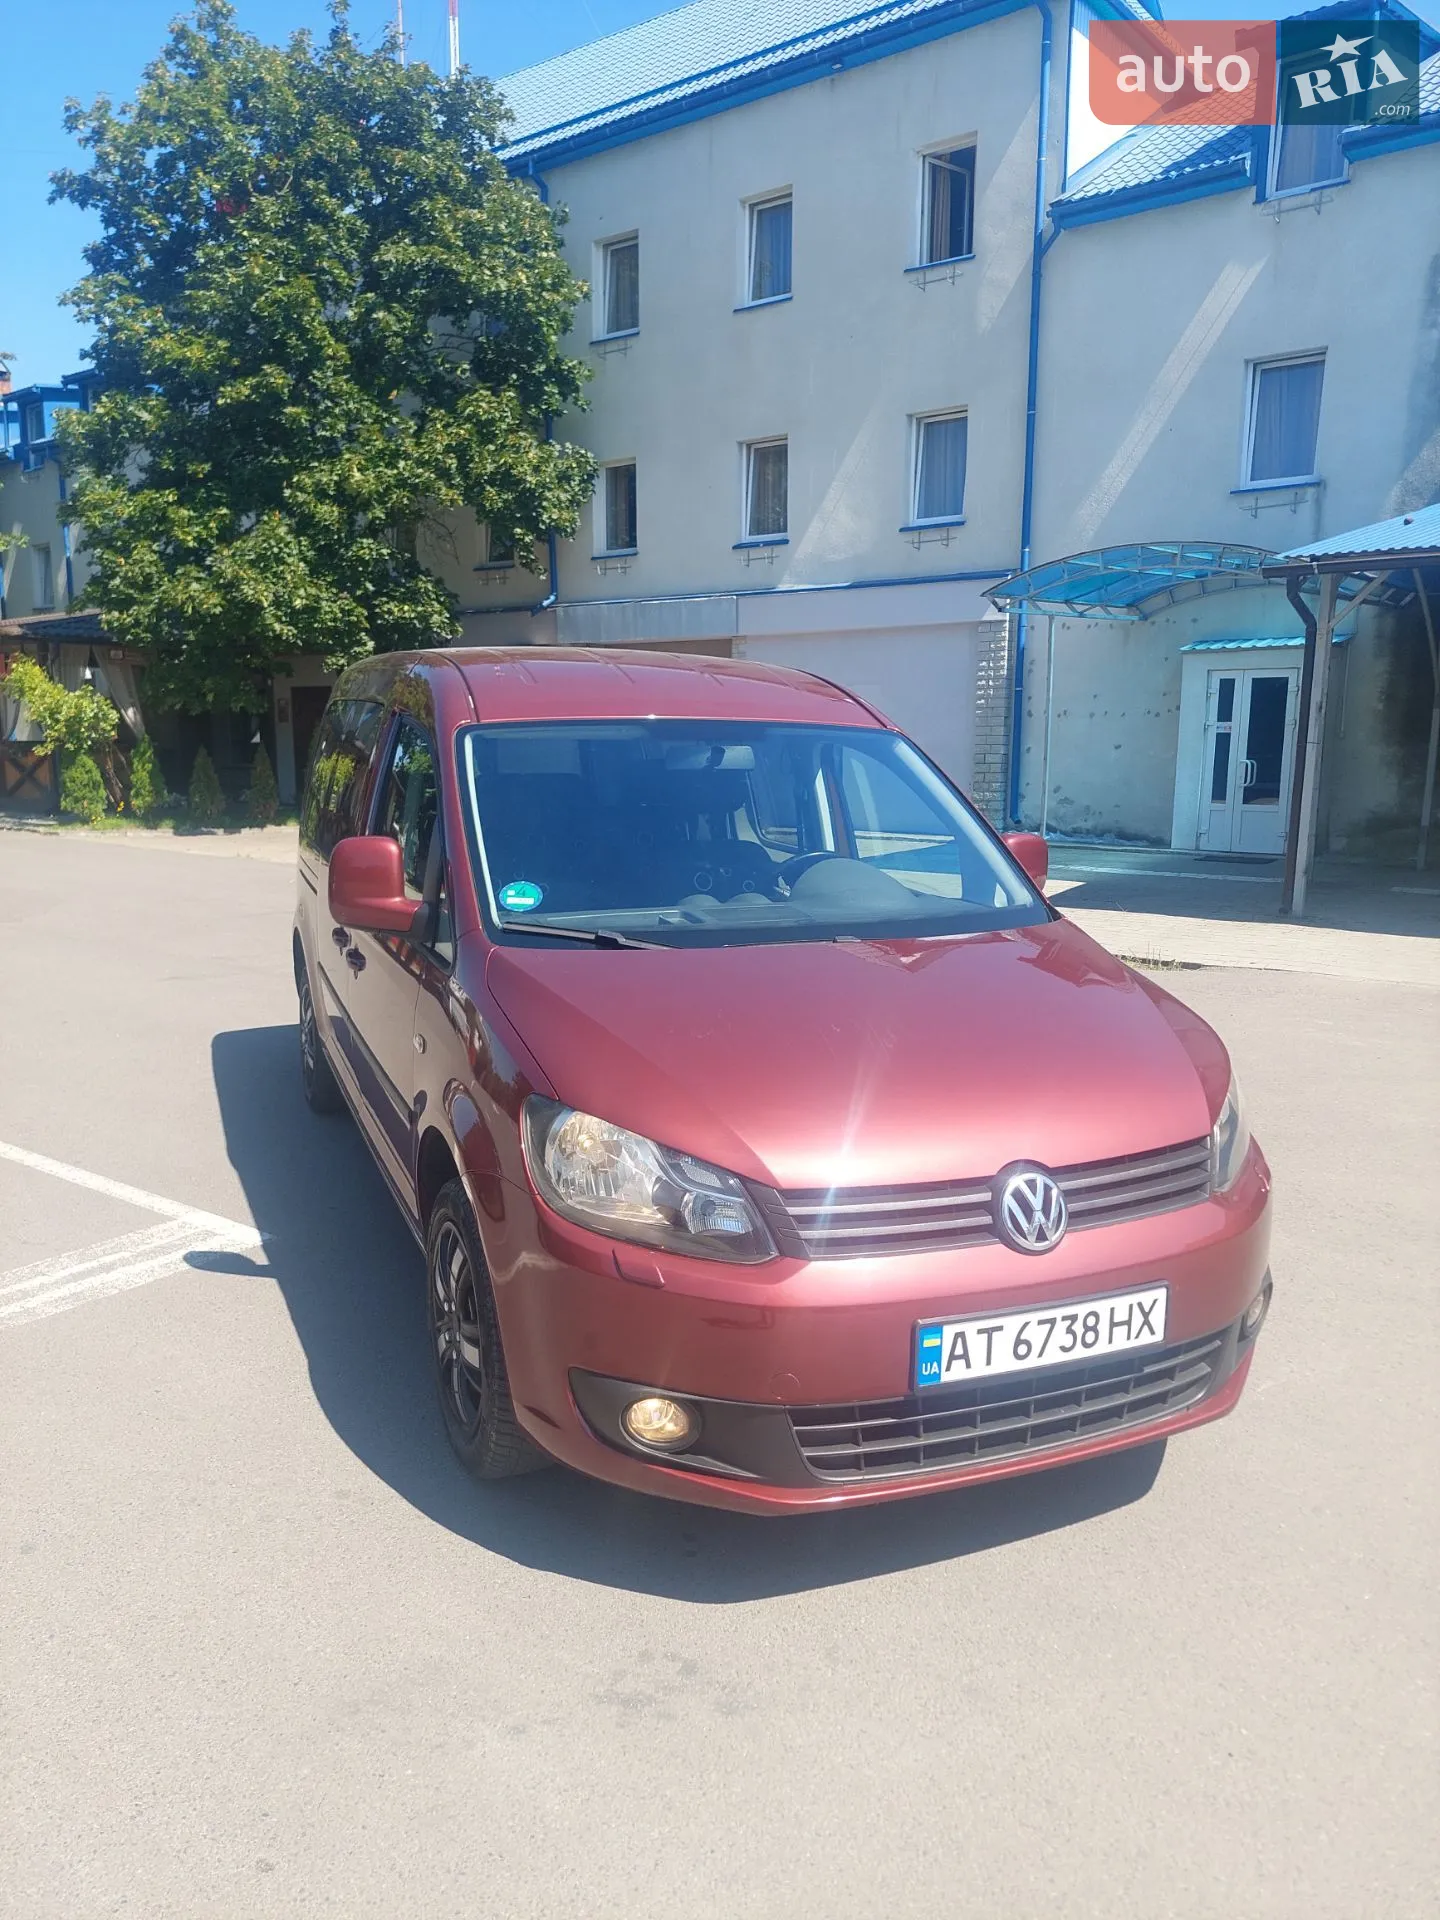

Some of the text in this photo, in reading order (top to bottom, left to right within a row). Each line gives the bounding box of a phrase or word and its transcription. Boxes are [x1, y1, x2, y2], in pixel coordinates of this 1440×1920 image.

[945, 1299, 1158, 1372] AT 6738 HX
[922, 1362, 939, 1376] UA
